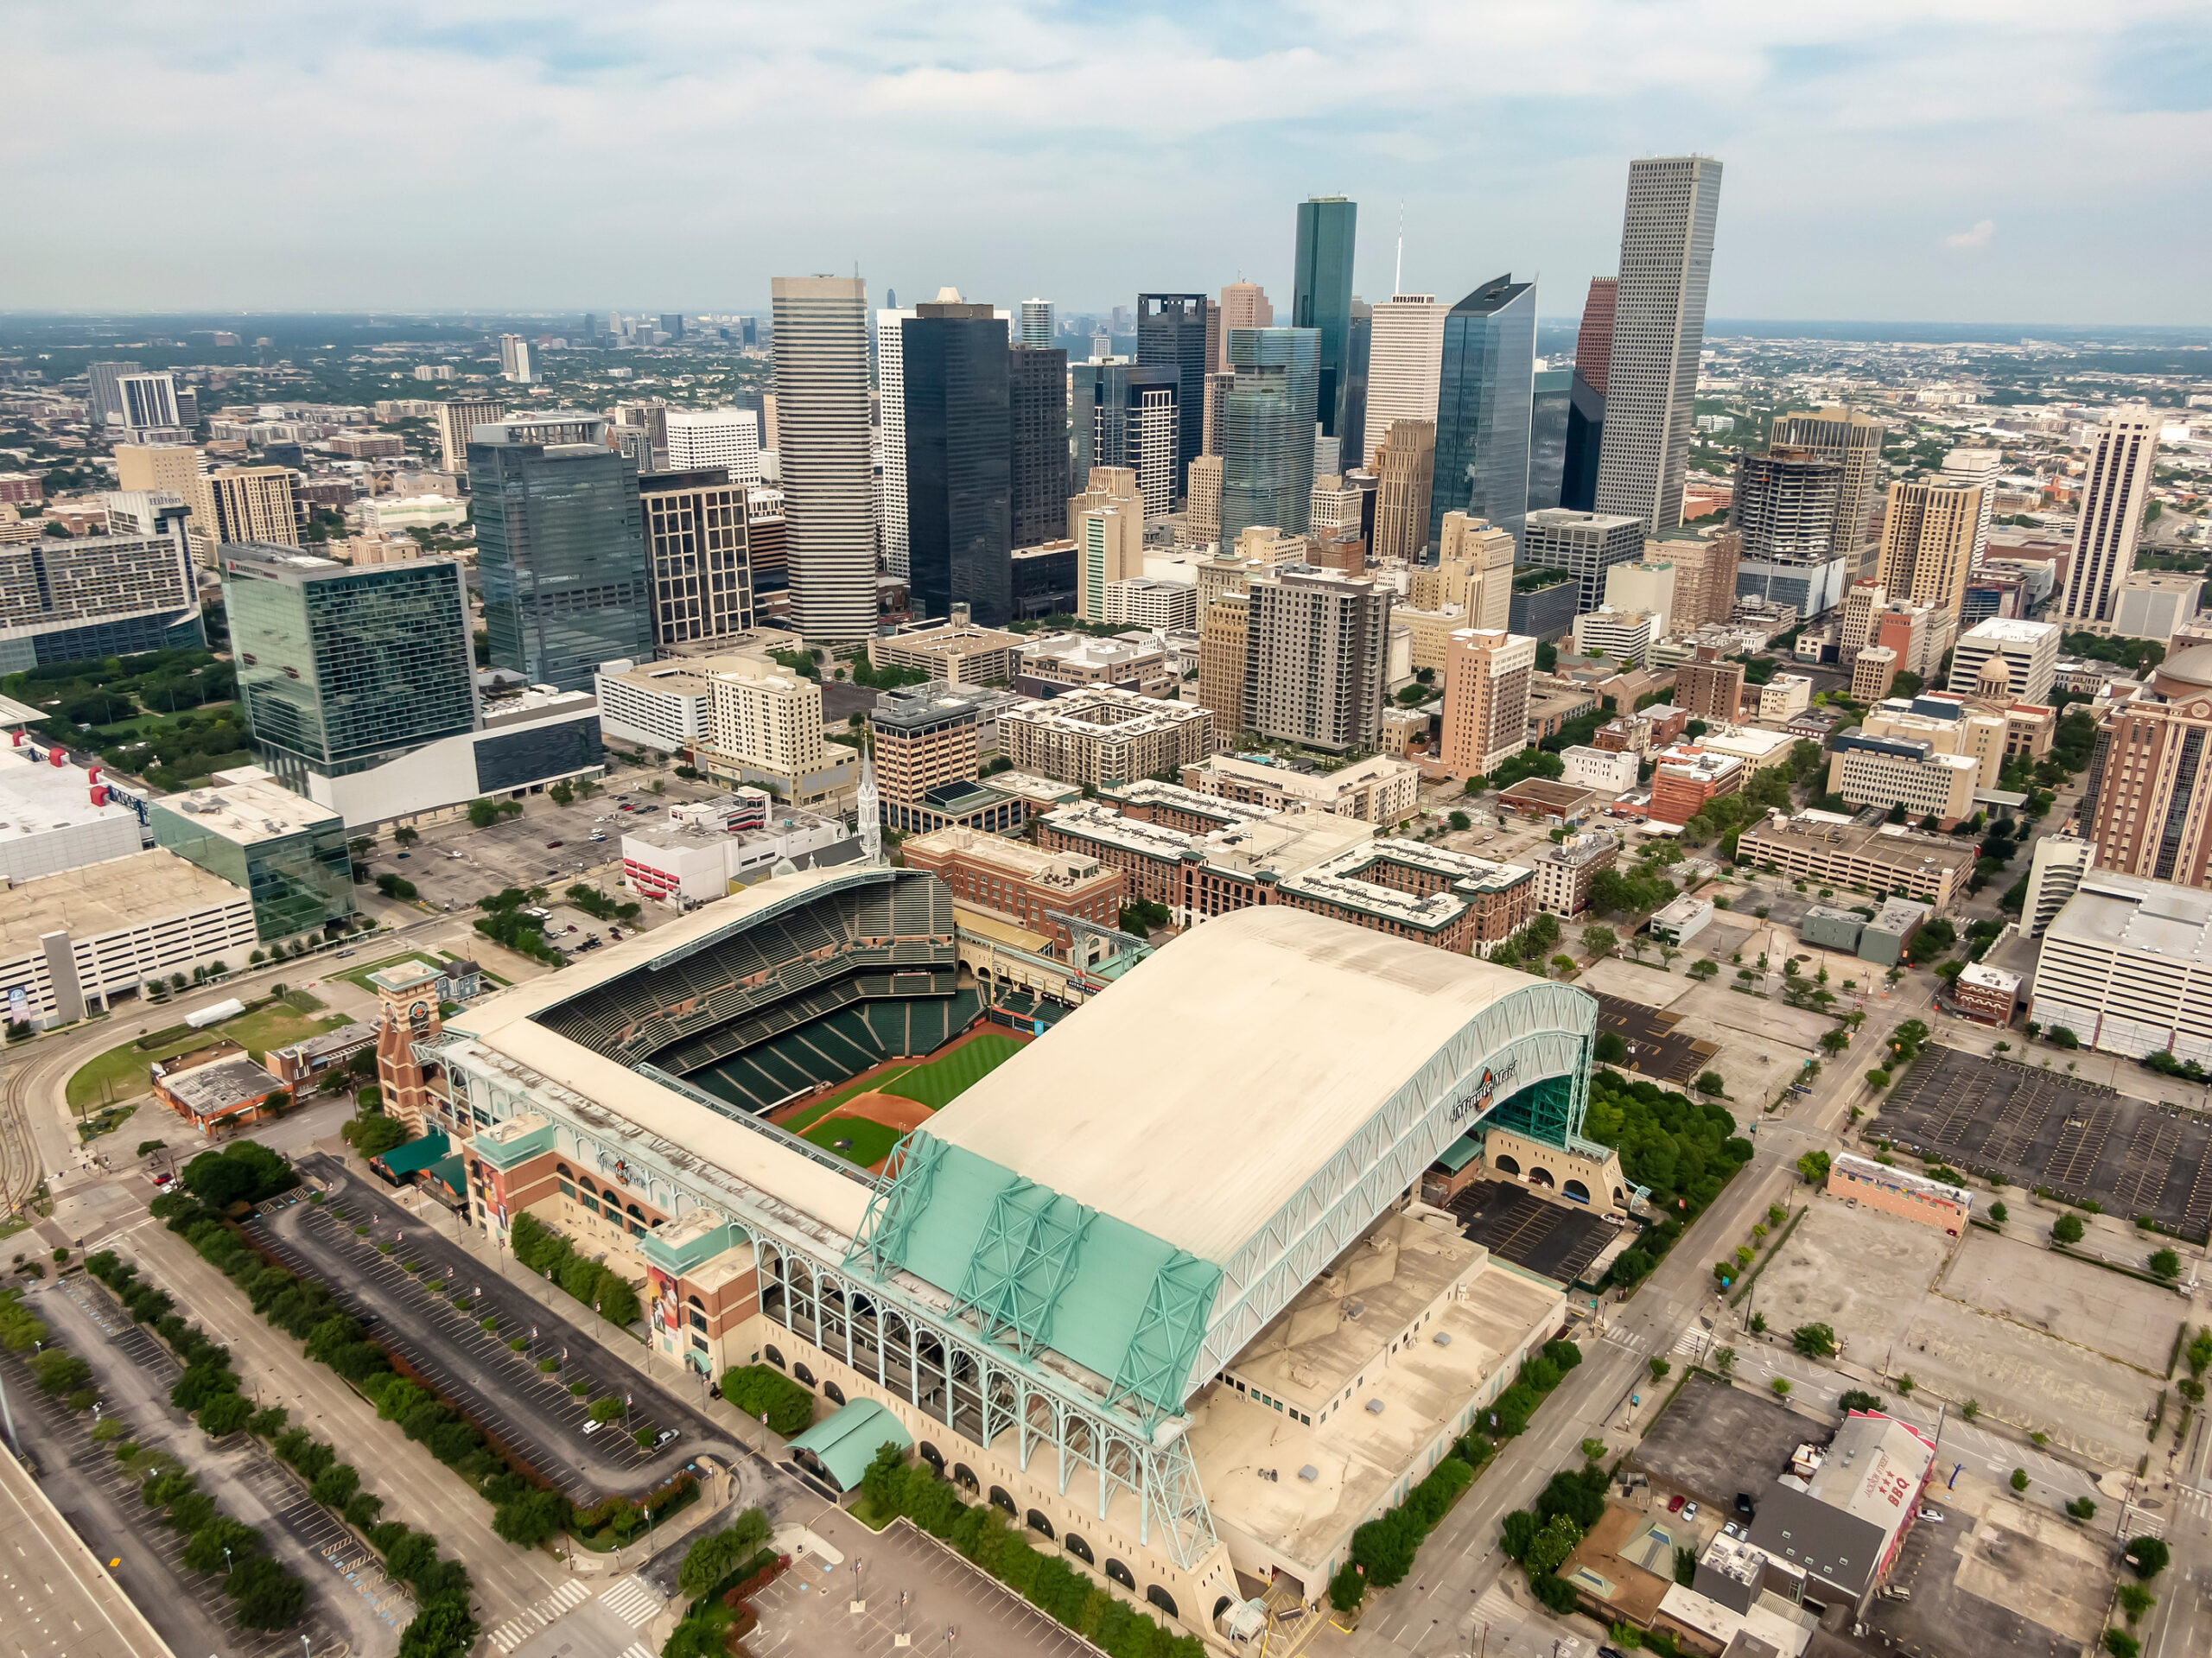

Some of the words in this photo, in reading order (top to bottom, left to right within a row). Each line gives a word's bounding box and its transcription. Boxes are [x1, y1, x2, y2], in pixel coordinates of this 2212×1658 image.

[149, 496, 181, 505] Hilton
[1452, 1080, 1492, 1122] Minute
[1492, 1059, 1518, 1089] Maid
[1887, 1477, 1911, 1508] BBQ
